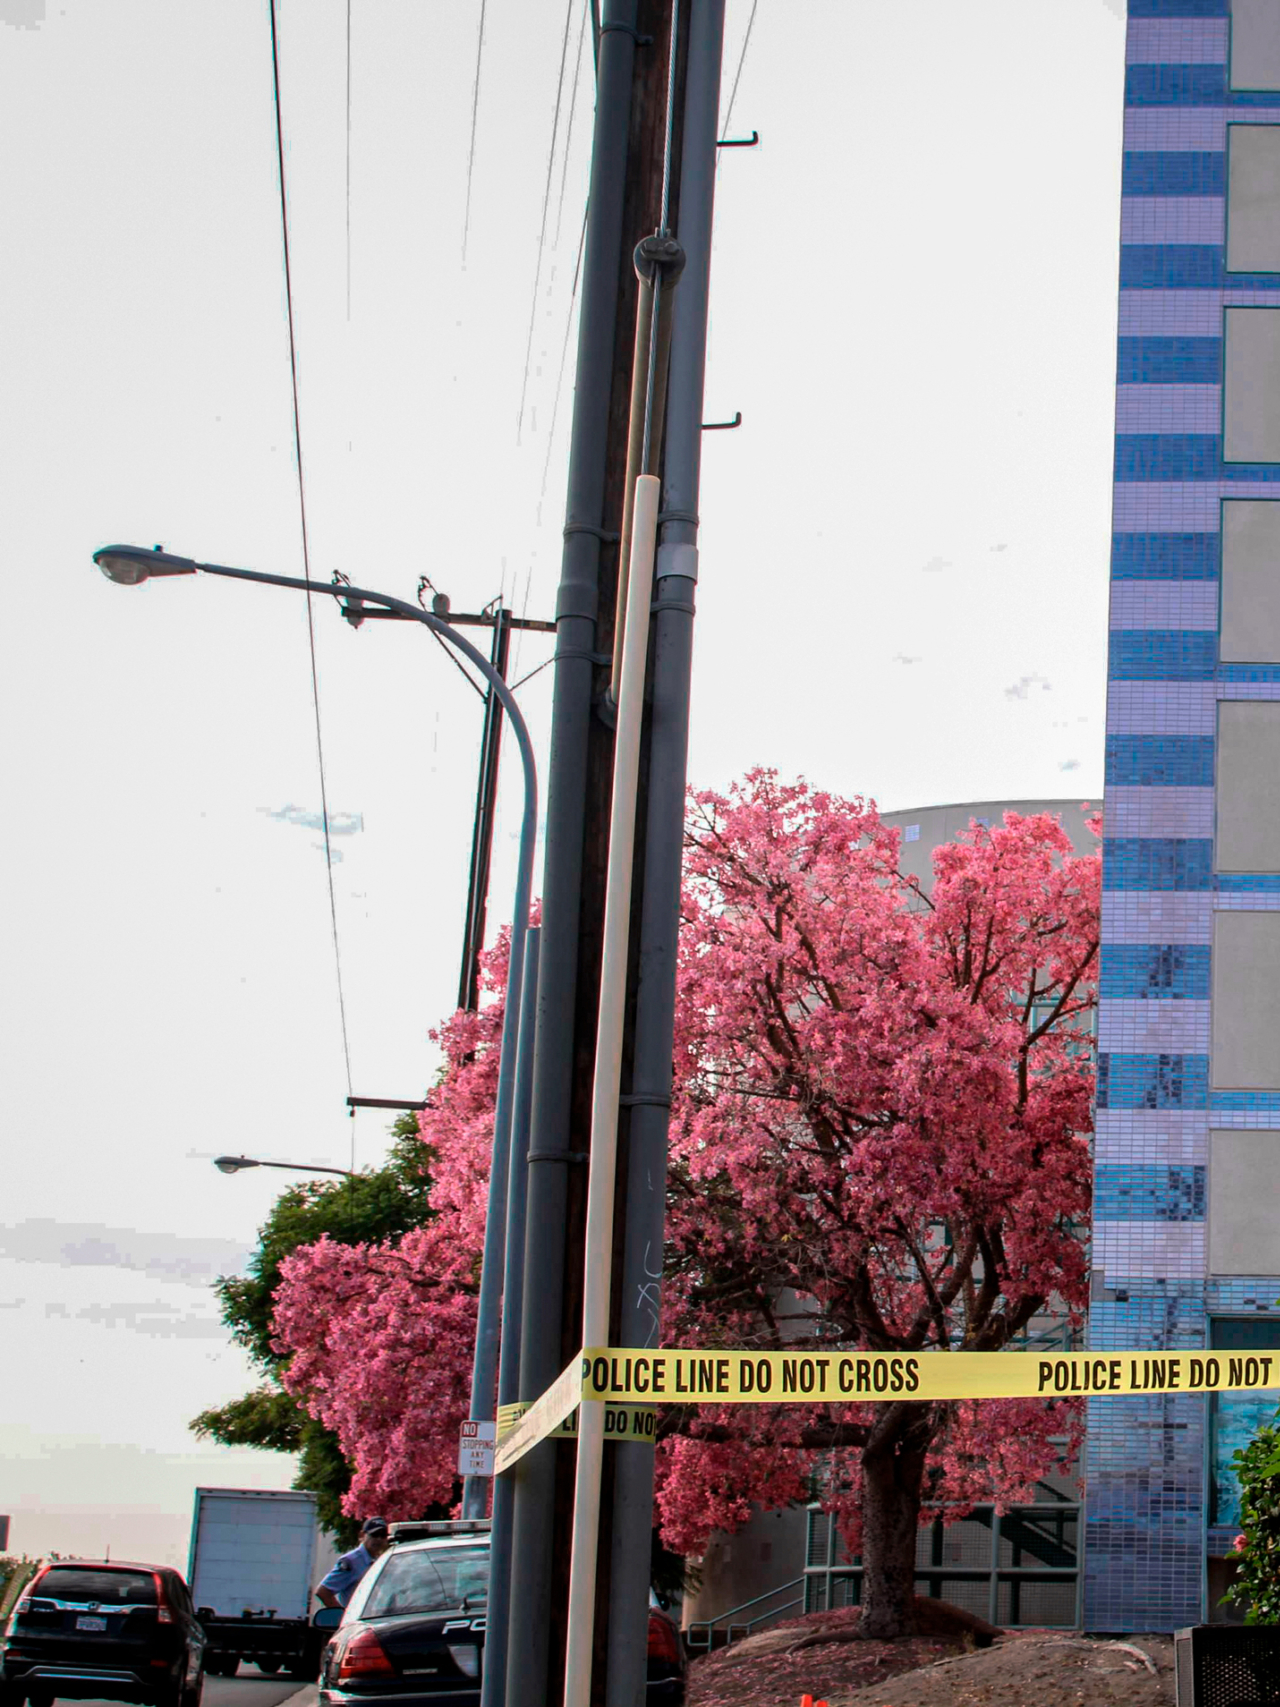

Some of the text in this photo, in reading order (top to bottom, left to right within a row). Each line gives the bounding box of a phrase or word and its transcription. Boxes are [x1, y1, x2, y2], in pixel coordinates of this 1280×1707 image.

[581, 1357, 920, 1393] POLICE LINE DO NOT CROSS
[1038, 1360, 1122, 1392] POLICE
[1130, 1359, 1181, 1390] LINE
[1189, 1358, 1220, 1388] DO
[1228, 1357, 1273, 1387] NOT
[463, 1423, 476, 1435] NO
[605, 1410, 628, 1434] DO
[462, 1439, 494, 1450] STOPPING
[470, 1460, 485, 1469] TIME
